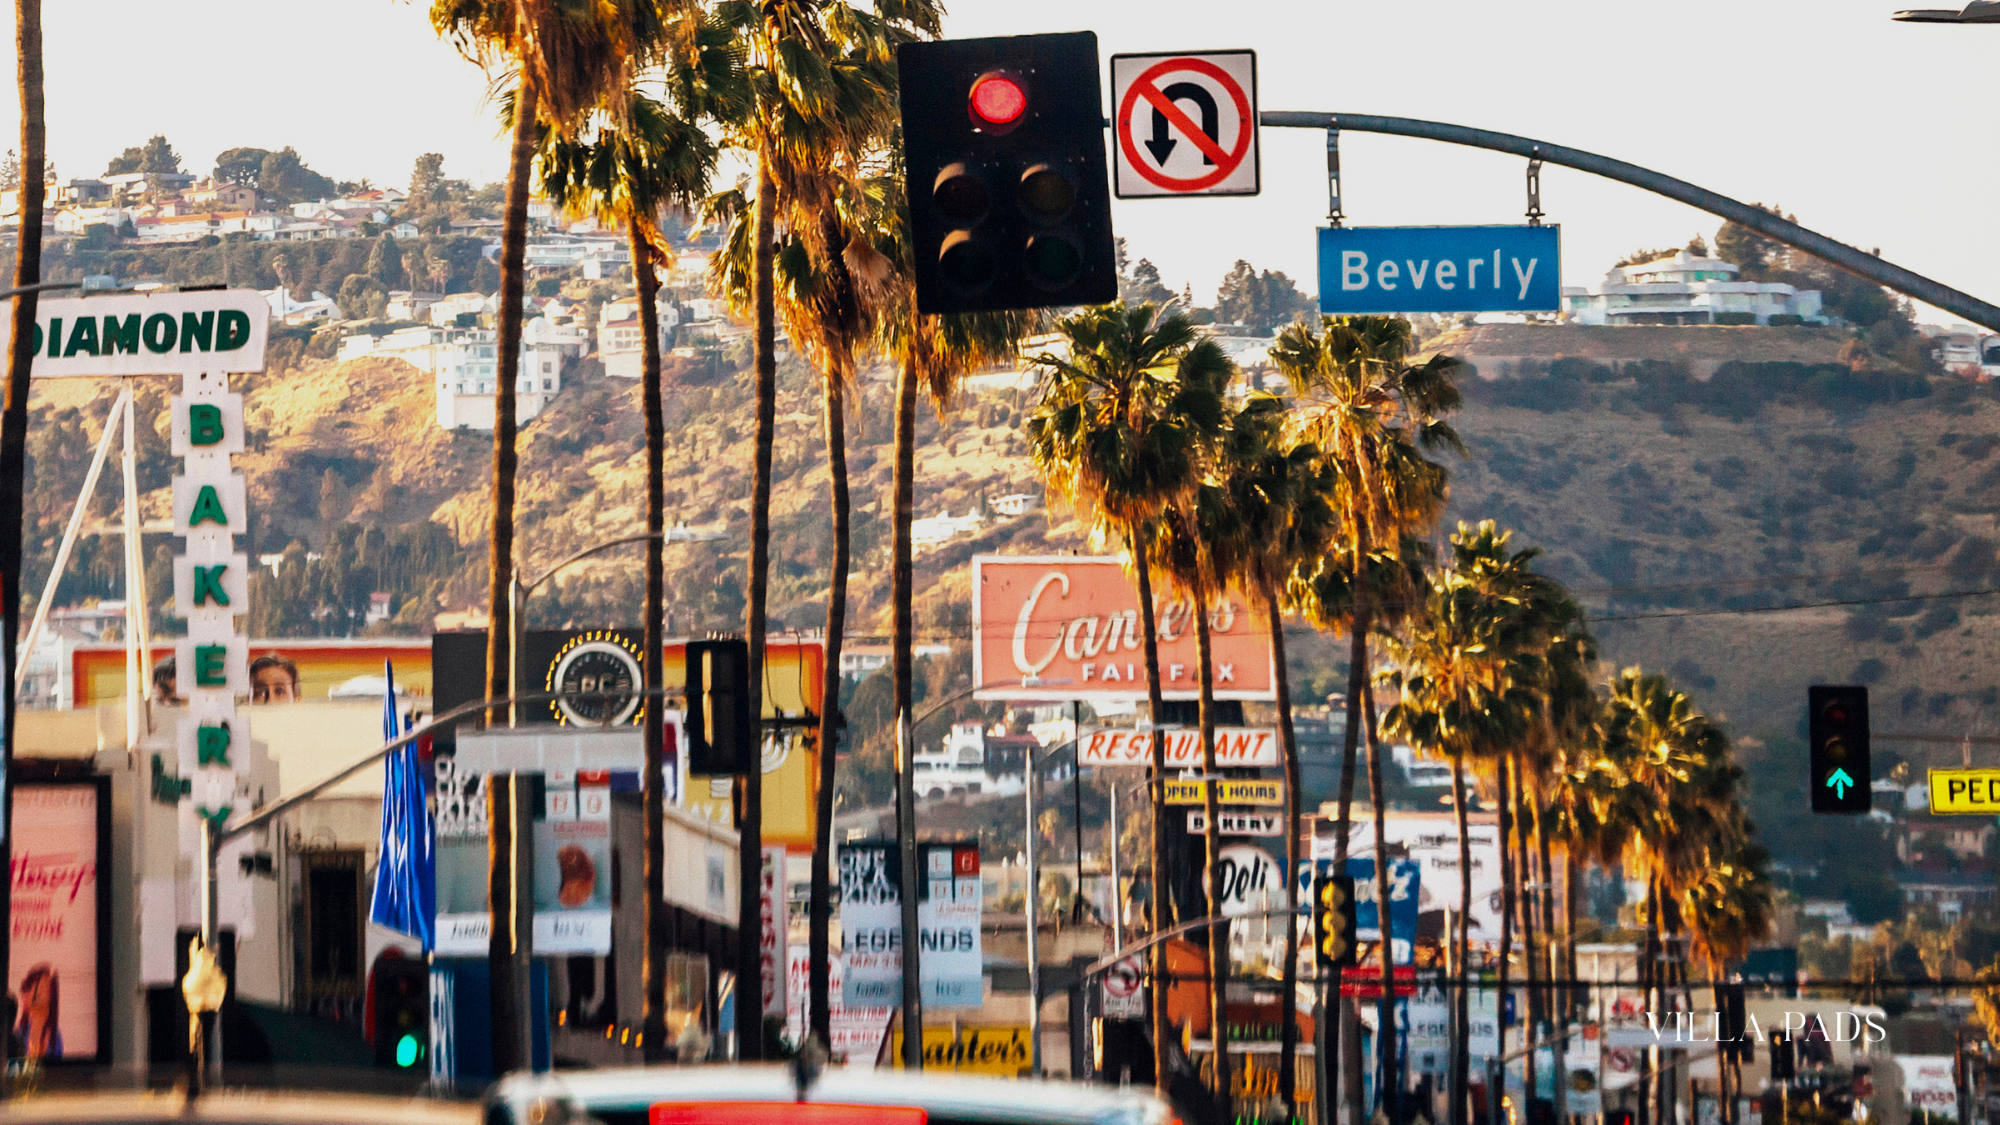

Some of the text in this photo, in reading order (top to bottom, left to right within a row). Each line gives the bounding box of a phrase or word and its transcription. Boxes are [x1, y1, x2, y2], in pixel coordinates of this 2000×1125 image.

[1341, 248, 1538, 300] Beverly
[1081, 662, 1235, 683] FAIFX
[1229, 785, 1277, 800] HOURS
[1948, 778, 2000, 804] PED
[1193, 816, 1275, 831] BKERY
[1219, 855, 1269, 902] Deli
